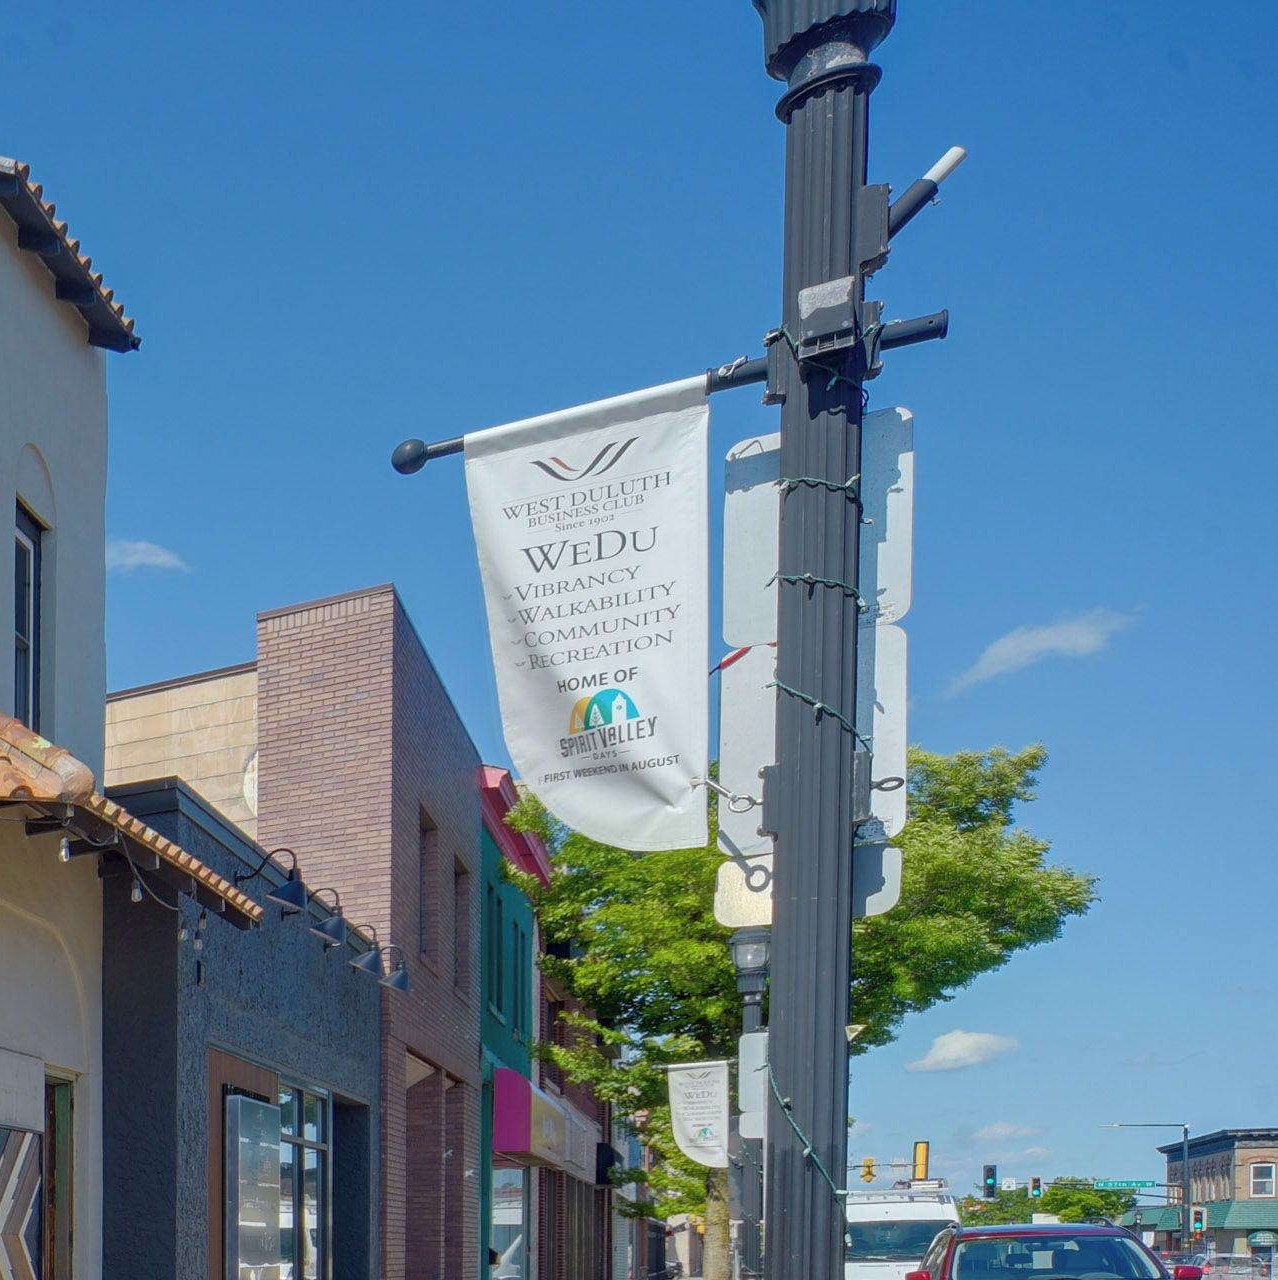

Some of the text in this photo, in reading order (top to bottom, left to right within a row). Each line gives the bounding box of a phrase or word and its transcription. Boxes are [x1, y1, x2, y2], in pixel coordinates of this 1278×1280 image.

[502, 471, 672, 520] WEST DULUTH
[528, 494, 645, 528] BUSINESS CLUB
[554, 514, 615, 533] Since 1902
[515, 565, 641, 601] VIBRANCY
[518, 580, 676, 625] WALKABILITY
[524, 604, 681, 648] COMMUNITY
[528, 630, 674, 670] RECREATION
[557, 666, 638, 693] HOME OF
[544, 754, 680, 783] FIRST WEEKEND IN AUGUST
[593, 750, 618, 760] DAYS
